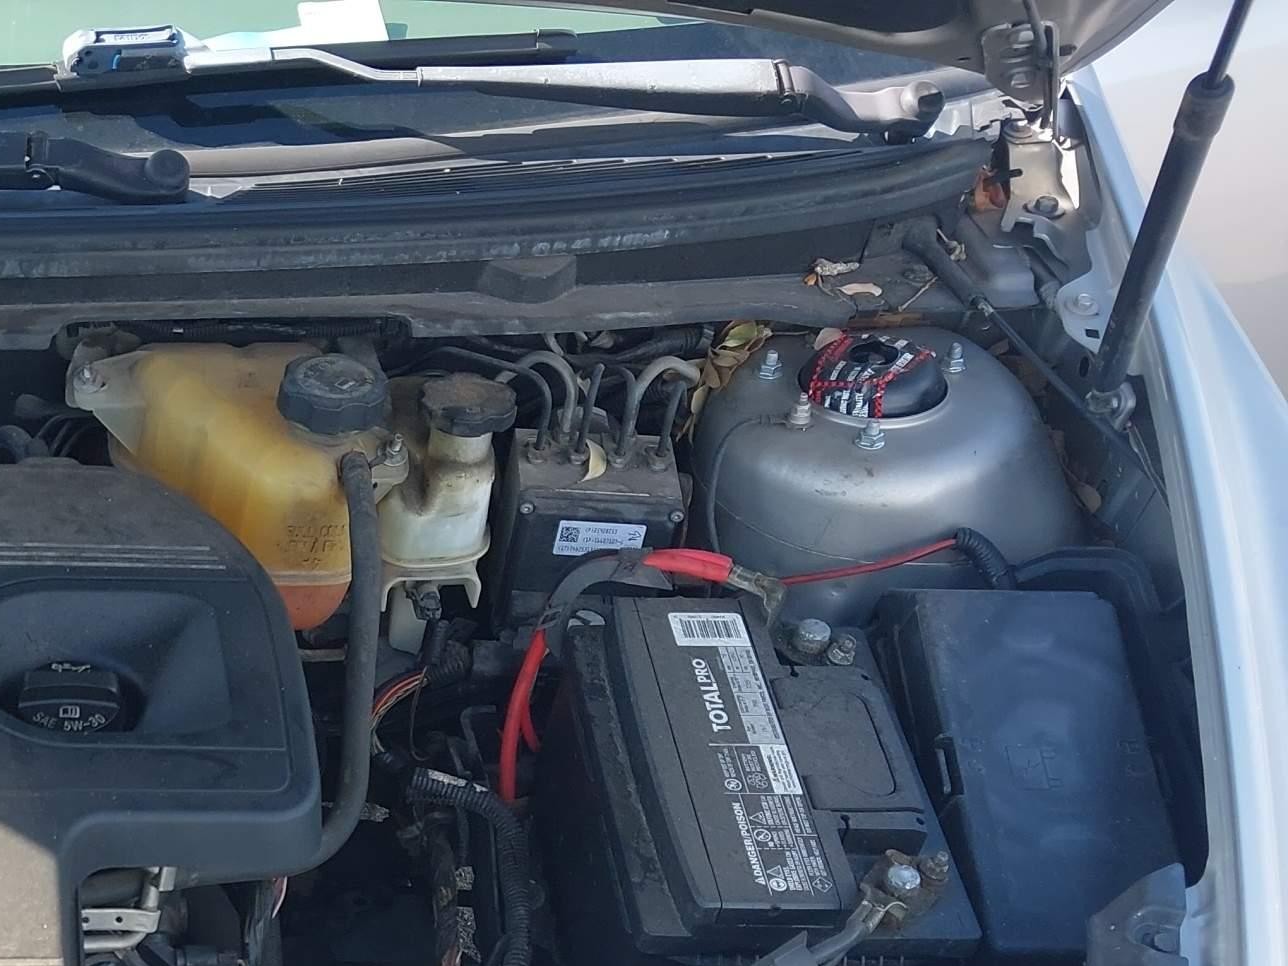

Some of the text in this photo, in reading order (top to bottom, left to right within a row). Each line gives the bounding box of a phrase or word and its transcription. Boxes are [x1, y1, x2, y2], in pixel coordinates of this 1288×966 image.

[33, 712, 106, 732] SAE 5W-30
[732, 802, 764, 877] DANGER/POISON
